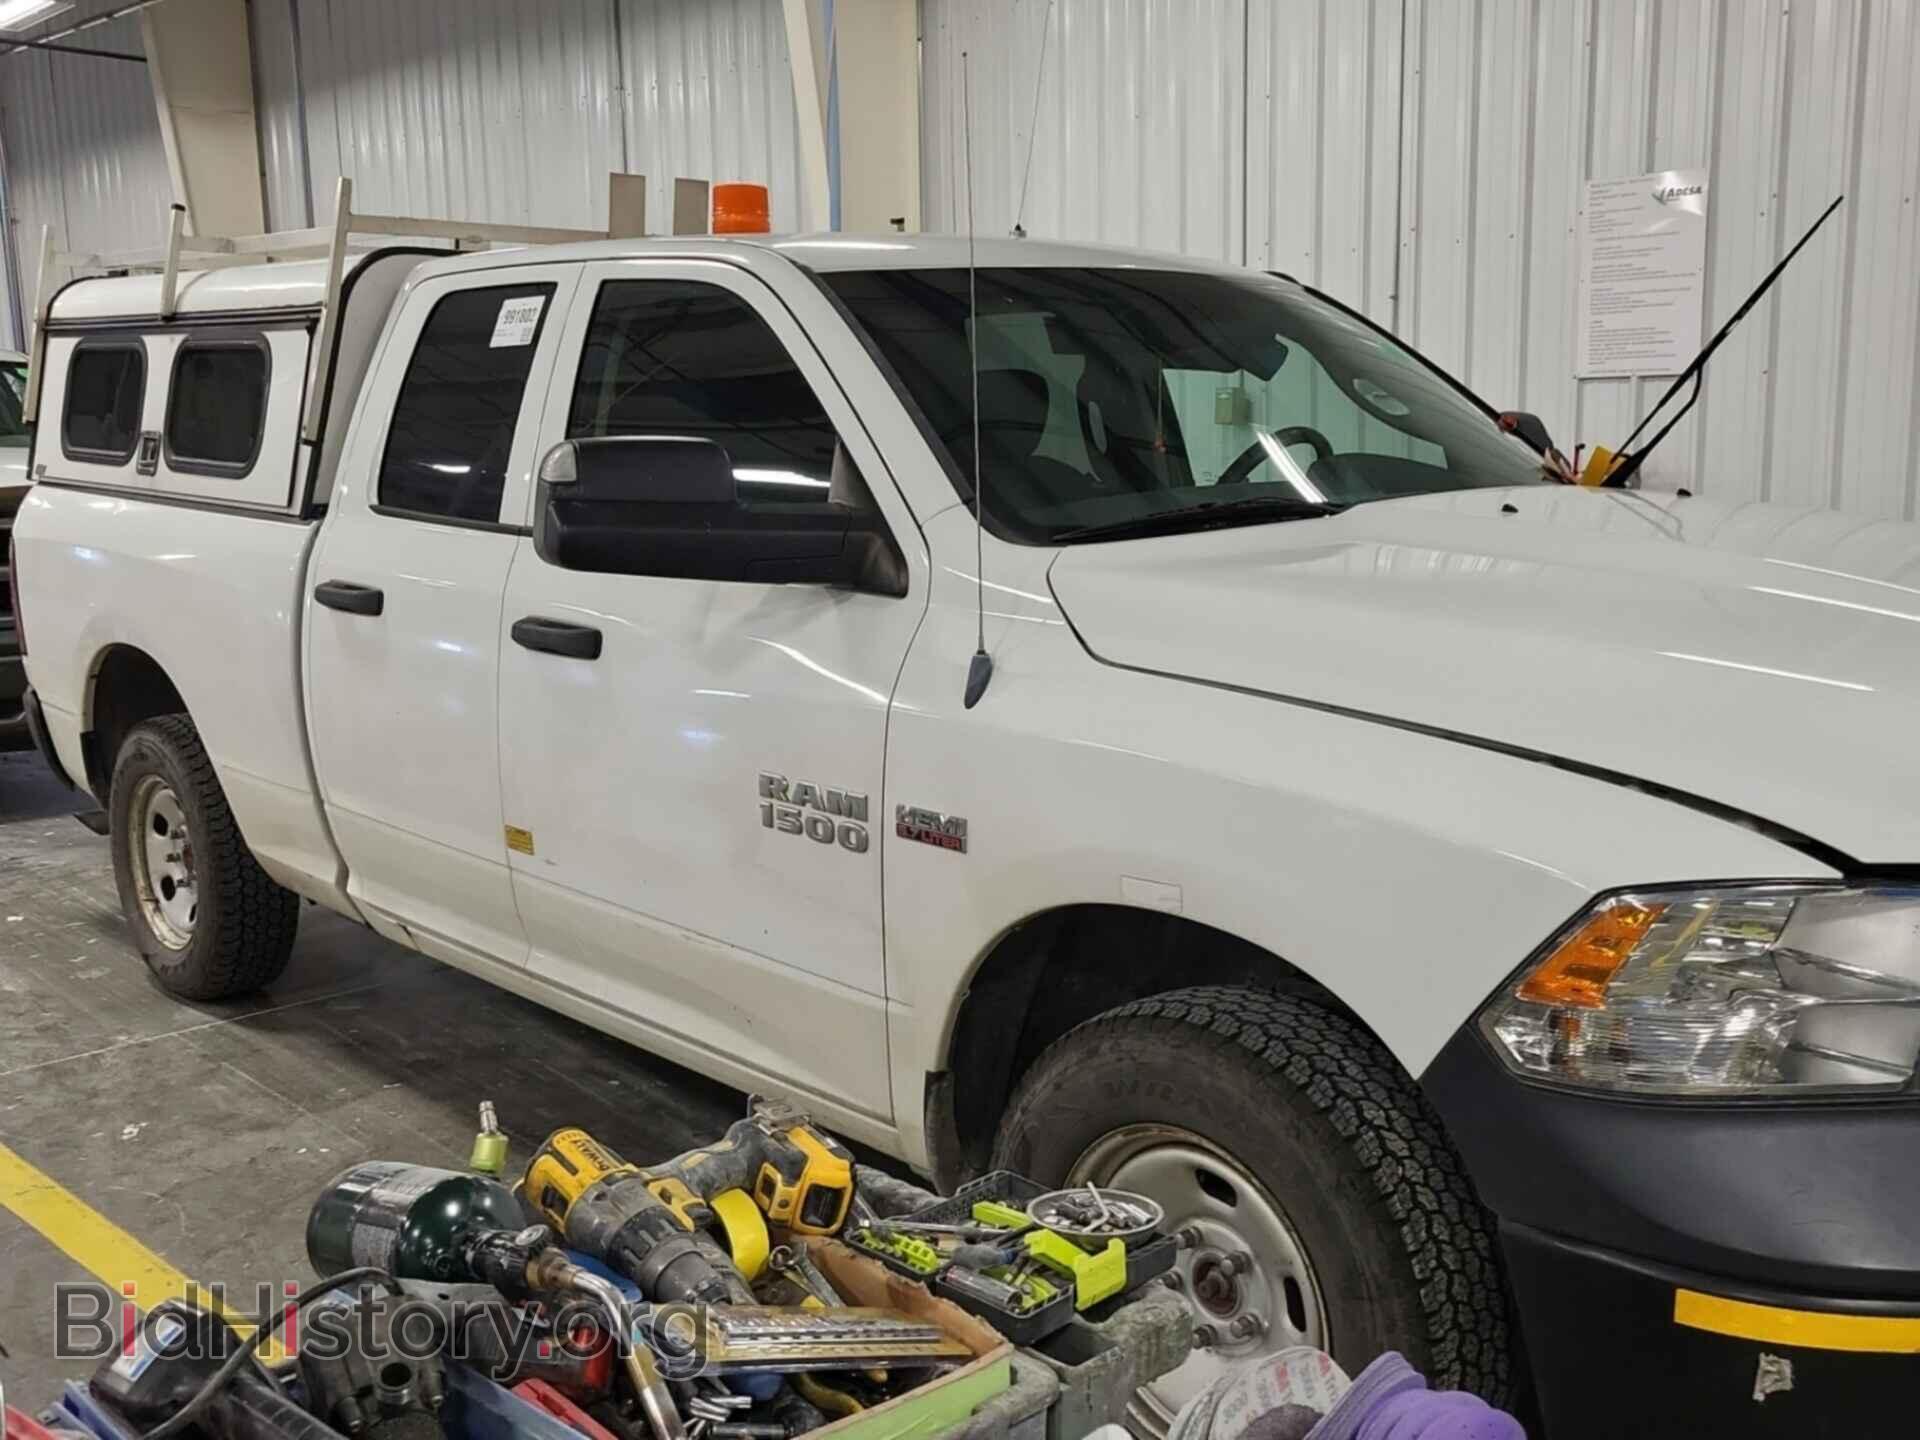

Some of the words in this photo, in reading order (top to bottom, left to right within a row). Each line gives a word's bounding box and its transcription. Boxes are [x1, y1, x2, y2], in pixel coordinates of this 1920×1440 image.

[758, 769, 869, 823] RAM
[759, 801, 870, 854] 1500
[896, 803, 968, 838] HEMI
[920, 829, 961, 850] LITER
